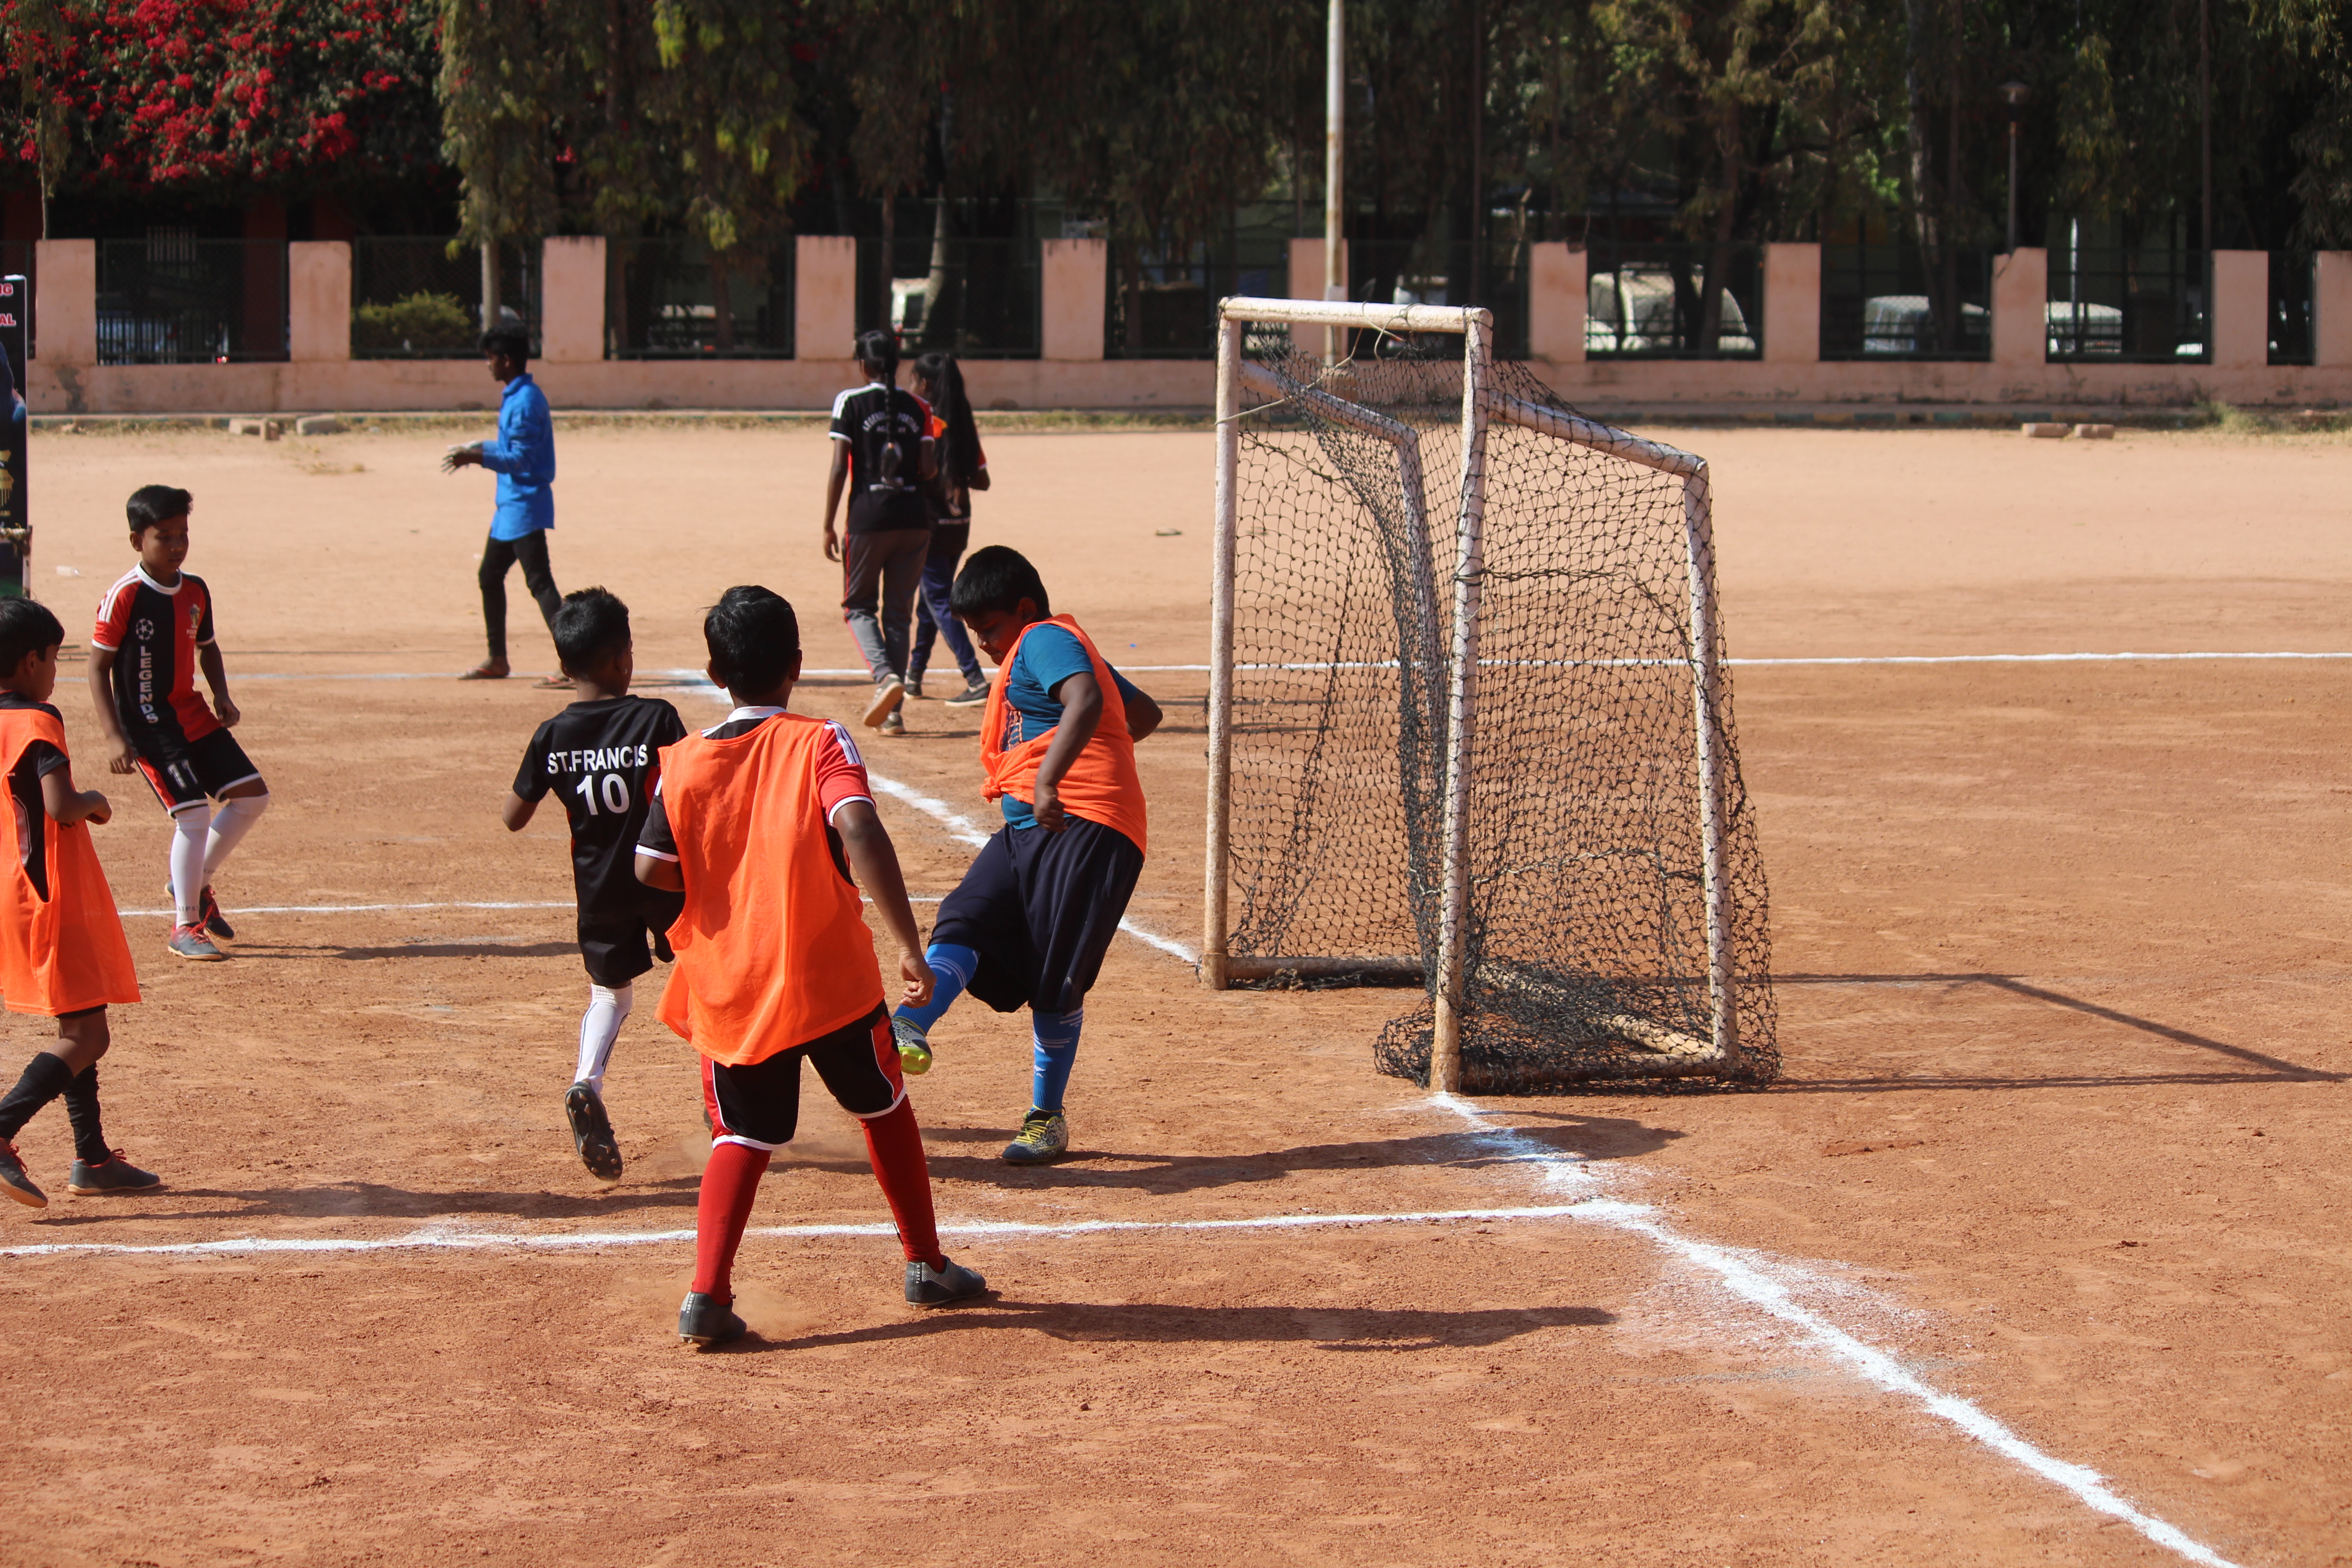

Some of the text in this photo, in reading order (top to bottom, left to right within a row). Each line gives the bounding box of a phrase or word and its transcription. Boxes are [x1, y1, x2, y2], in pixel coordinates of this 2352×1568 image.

[0, 283, 14, 296] G
[138, 645, 159, 724] LEGENDS
[167, 759, 198, 789] 11
[548, 744, 648, 774] ST.FRANCIS
[577, 773, 630, 815] 10
[686, 1294, 694, 1314] KIPSTA
